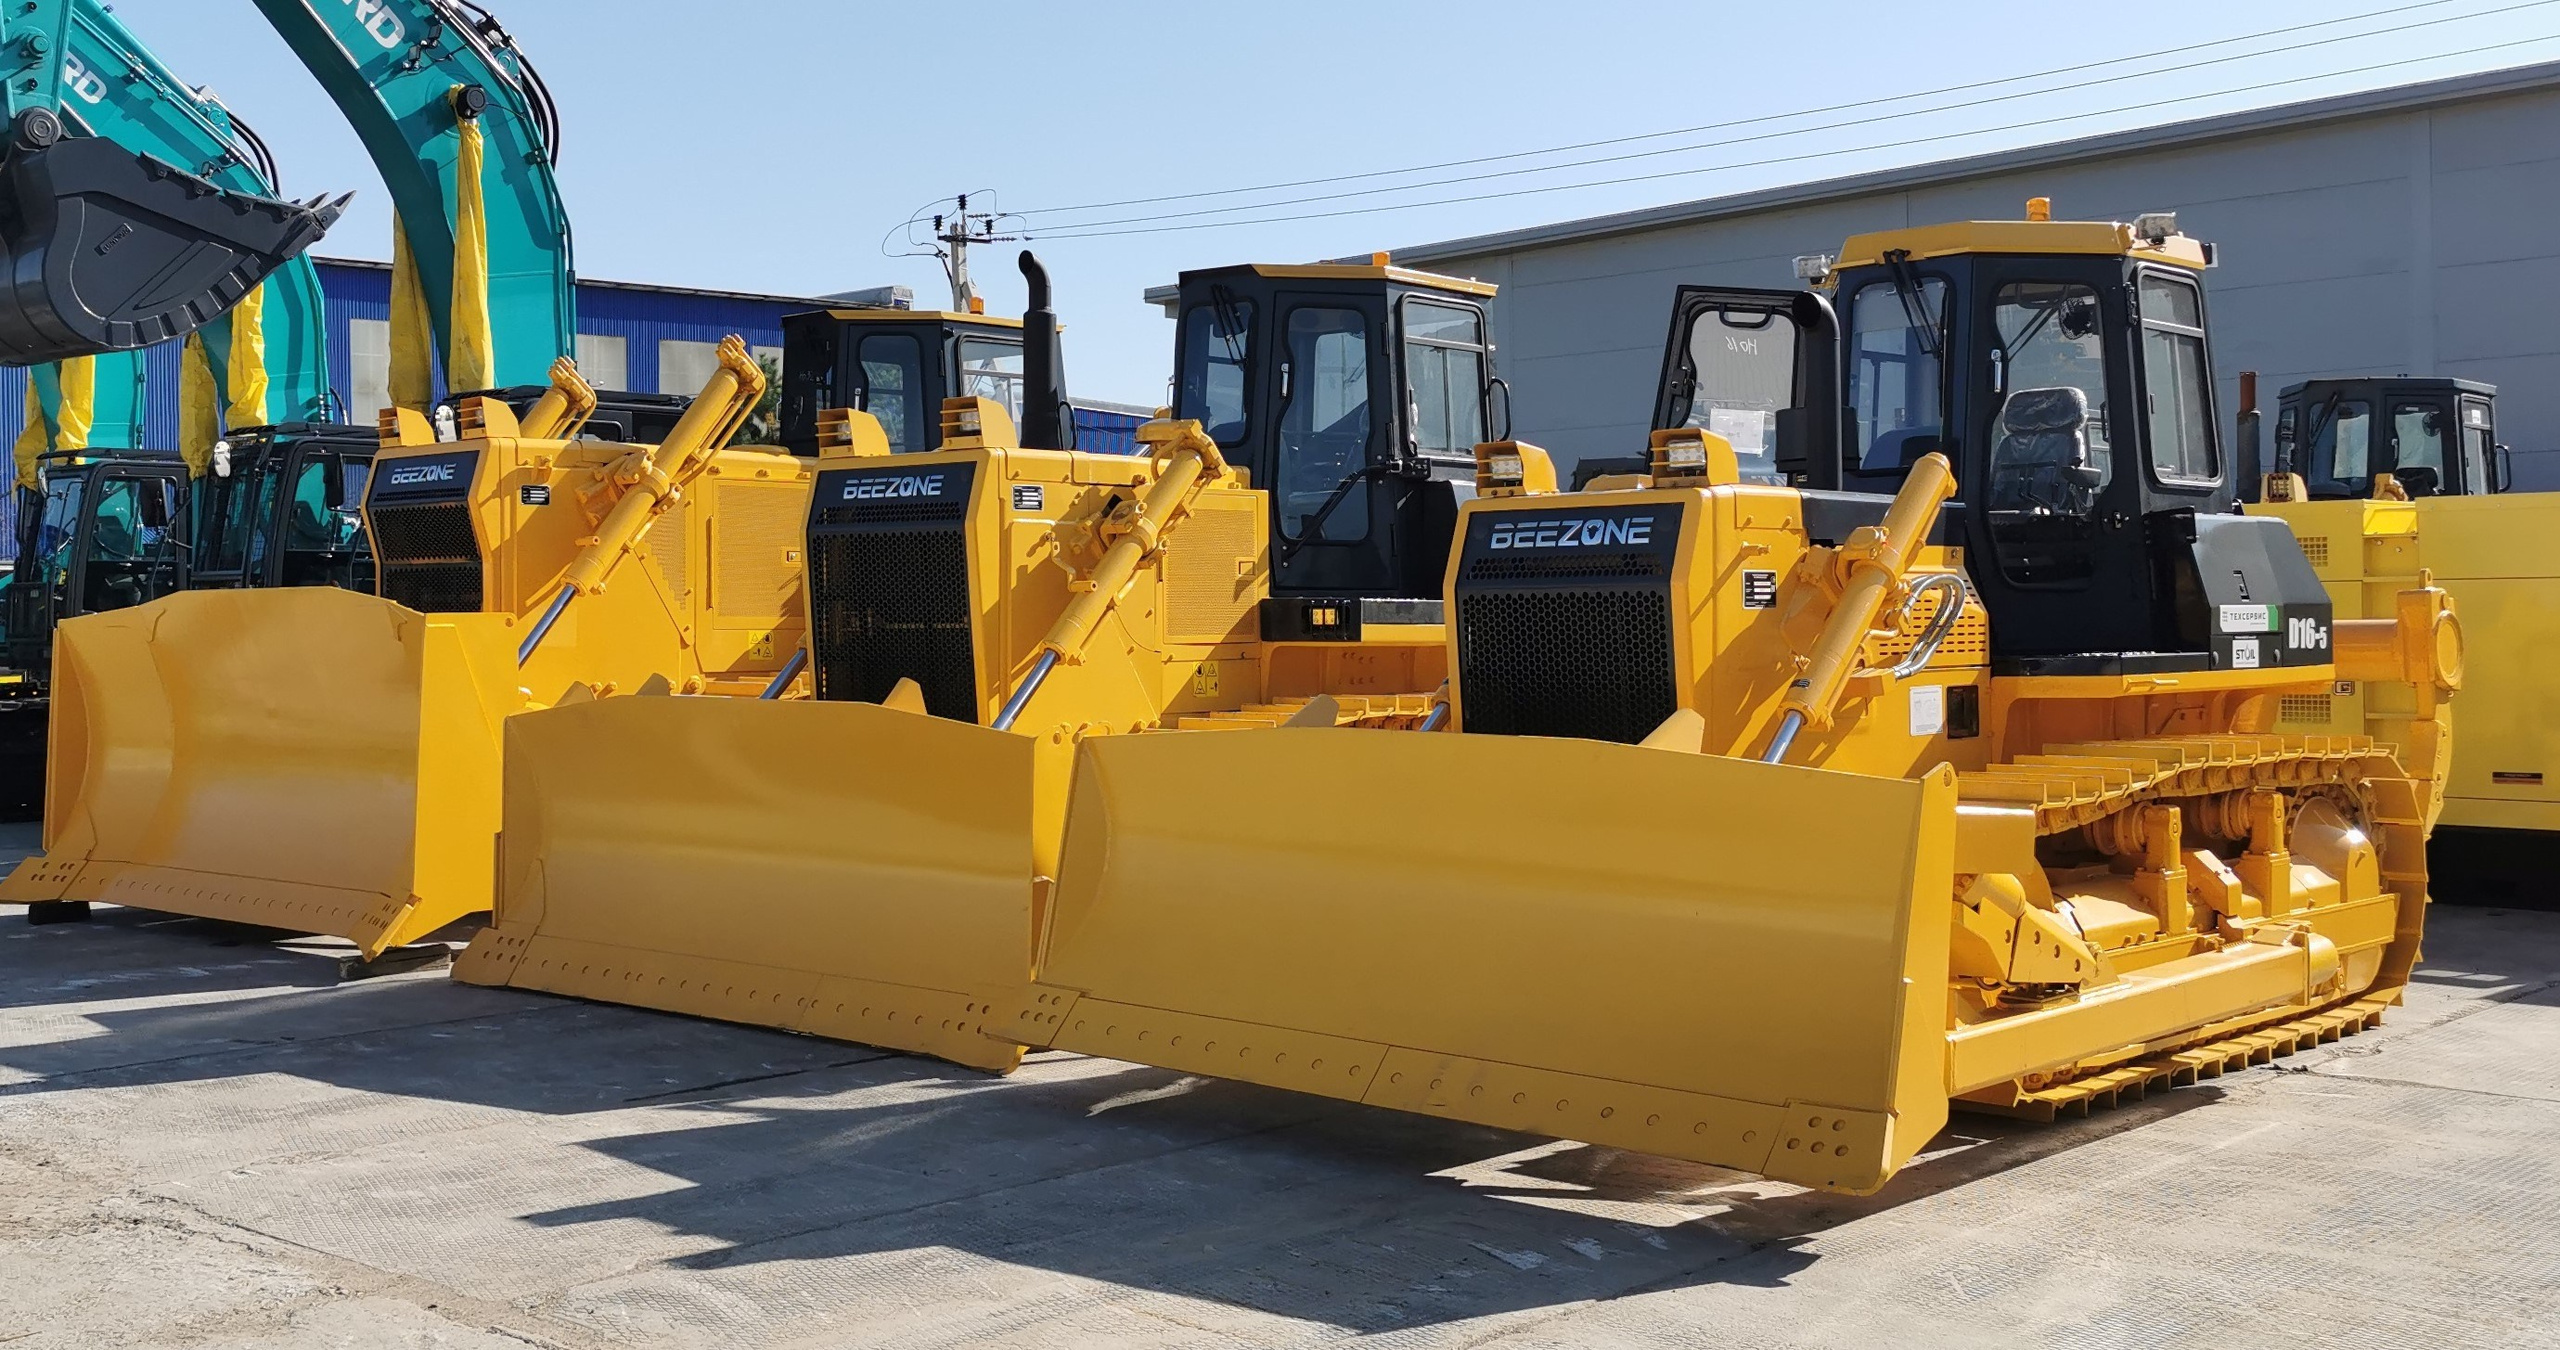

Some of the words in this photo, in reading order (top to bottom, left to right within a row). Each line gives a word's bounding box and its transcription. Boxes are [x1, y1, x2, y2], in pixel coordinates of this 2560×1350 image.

[391, 463, 457, 484] BEEZONE
[843, 475, 945, 500] BEEZONE
[1490, 516, 1655, 549] BEEZONE
[2288, 617, 2328, 650] D16-5
